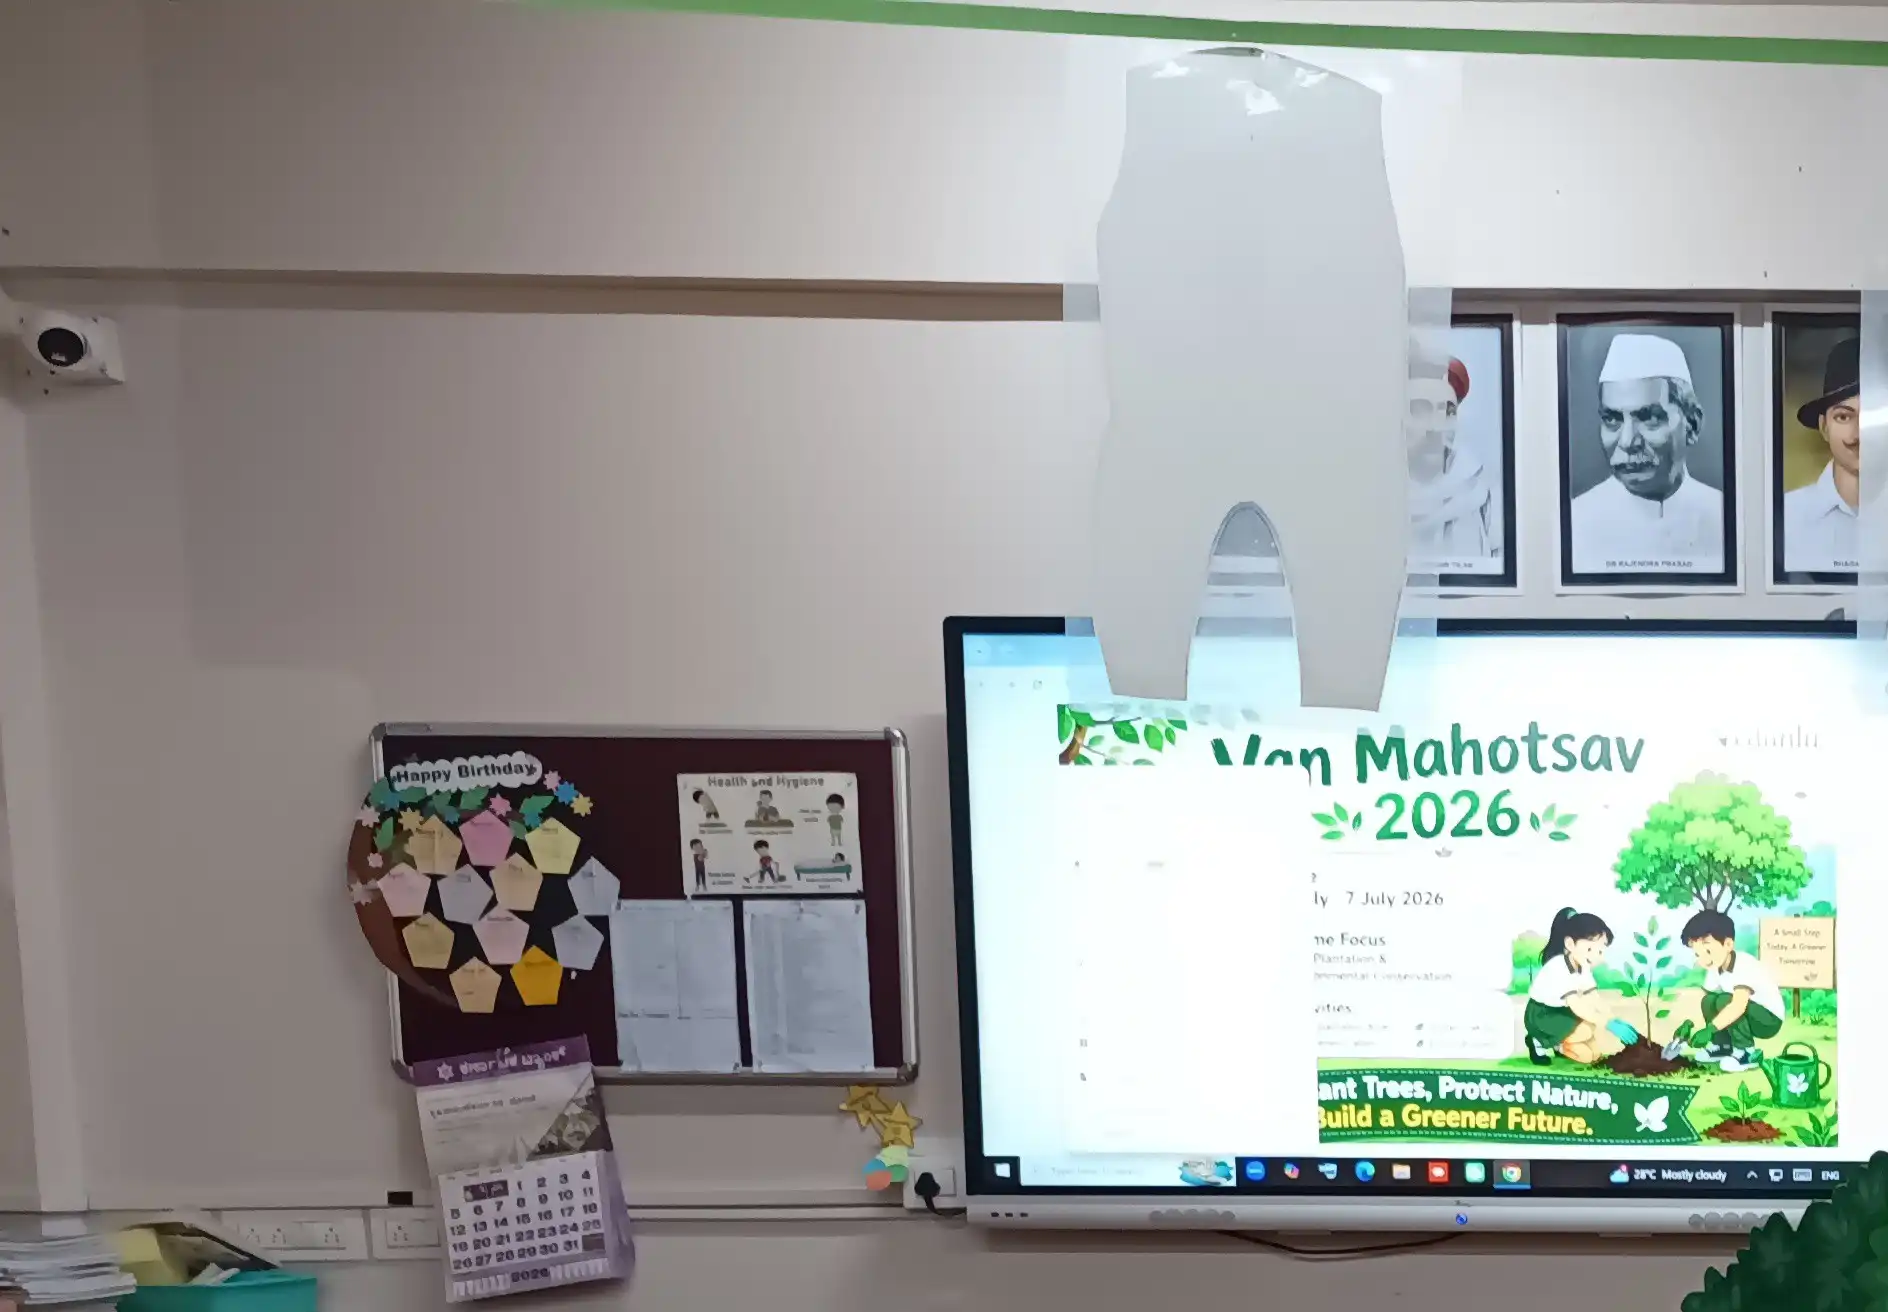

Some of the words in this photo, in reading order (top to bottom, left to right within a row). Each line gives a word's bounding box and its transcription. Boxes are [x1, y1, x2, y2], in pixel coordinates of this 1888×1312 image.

[1355, 721, 1645, 783] Mahotsav
[397, 769, 451, 788] Happy
[457, 761, 535, 779] Birthday
[707, 776, 747, 787] Health
[751, 777, 773, 787] and
[777, 776, 824, 789] Hygiene
[1375, 788, 1520, 841] 2026
[1314, 891, 1328, 908] ly
[1346, 892, 1354, 905] 7
[1362, 891, 1395, 908] July
[1403, 891, 1444, 905] 2026
[1341, 932, 1386, 947] Focus
[1318, 1077, 1357, 1100] ant
[1362, 1075, 1432, 1102] Trees,
[1438, 1076, 1525, 1102] Protect
[1532, 1081, 1619, 1115] Nature,
[1319, 1103, 1372, 1129] Build
[1380, 1108, 1395, 1127] a
[1402, 1104, 1501, 1129] Greener
[1508, 1106, 1593, 1135] Future.
[517, 1180, 523, 1191] 1
[537, 1177, 547, 1187] 2
[559, 1173, 568, 1184] 3
[582, 1169, 591, 1179] 4
[1662, 1169, 1693, 1182] Mostly
[1695, 1169, 1727, 1183] cloudy
[1821, 1170, 1840, 1180] ENG
[474, 1205, 483, 1215] 6
[495, 1201, 503, 1211] 7
[558, 1190, 573, 1201] 10
[583, 1187, 593, 1197] 11
[451, 1225, 466, 1235] 12
[473, 1222, 488, 1232] 13
[494, 1218, 508, 1228] 14
[561, 1207, 574, 1217] 17
[473, 1238, 491, 1249] 20
[496, 1234, 510, 1245] 21
[515, 1231, 535, 1242] 22
[537, 1227, 557, 1238] 23
[559, 1223, 578, 1234] 24
[475, 1254, 491, 1266] 27
[540, 1243, 558, 1255] 30
[564, 1240, 578, 1250] 31
